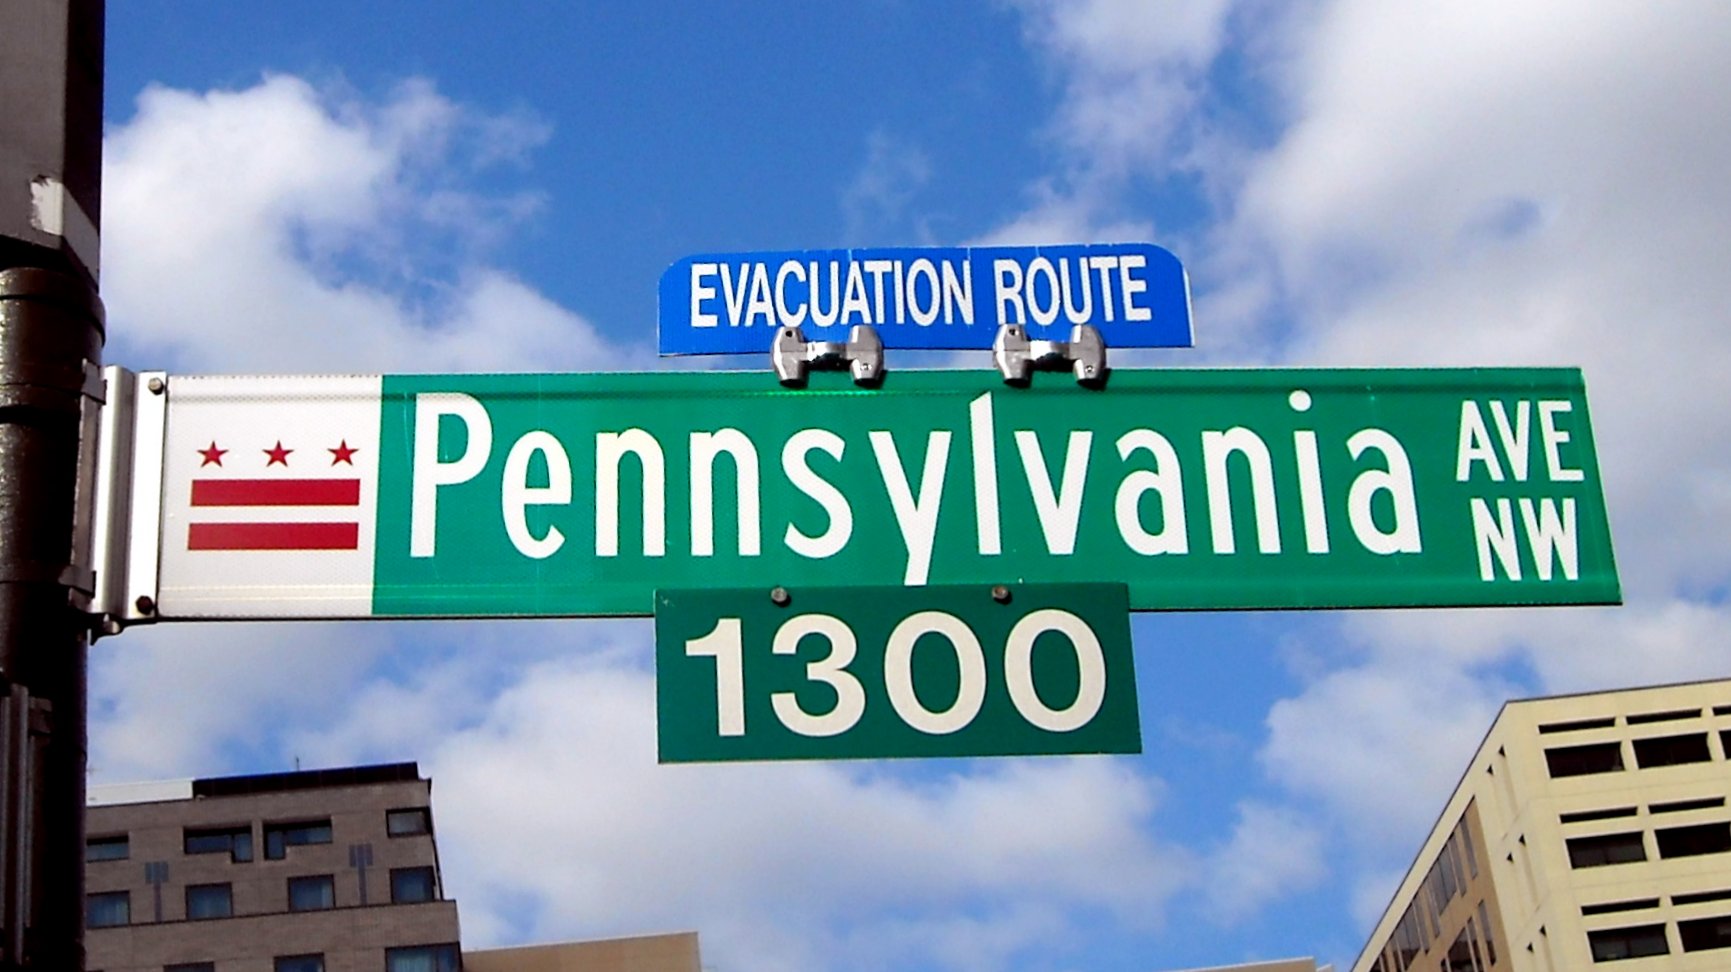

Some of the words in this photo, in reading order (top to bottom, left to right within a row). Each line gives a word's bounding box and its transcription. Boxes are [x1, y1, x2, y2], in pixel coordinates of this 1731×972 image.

[691, 258, 973, 327] EVACUATION
[994, 255, 1152, 325] ROUTE
[1456, 400, 1585, 482] AVE
[410, 390, 1422, 586] Pennsylvania
[1470, 498, 1579, 581] NW
[685, 609, 1106, 737] 1300
